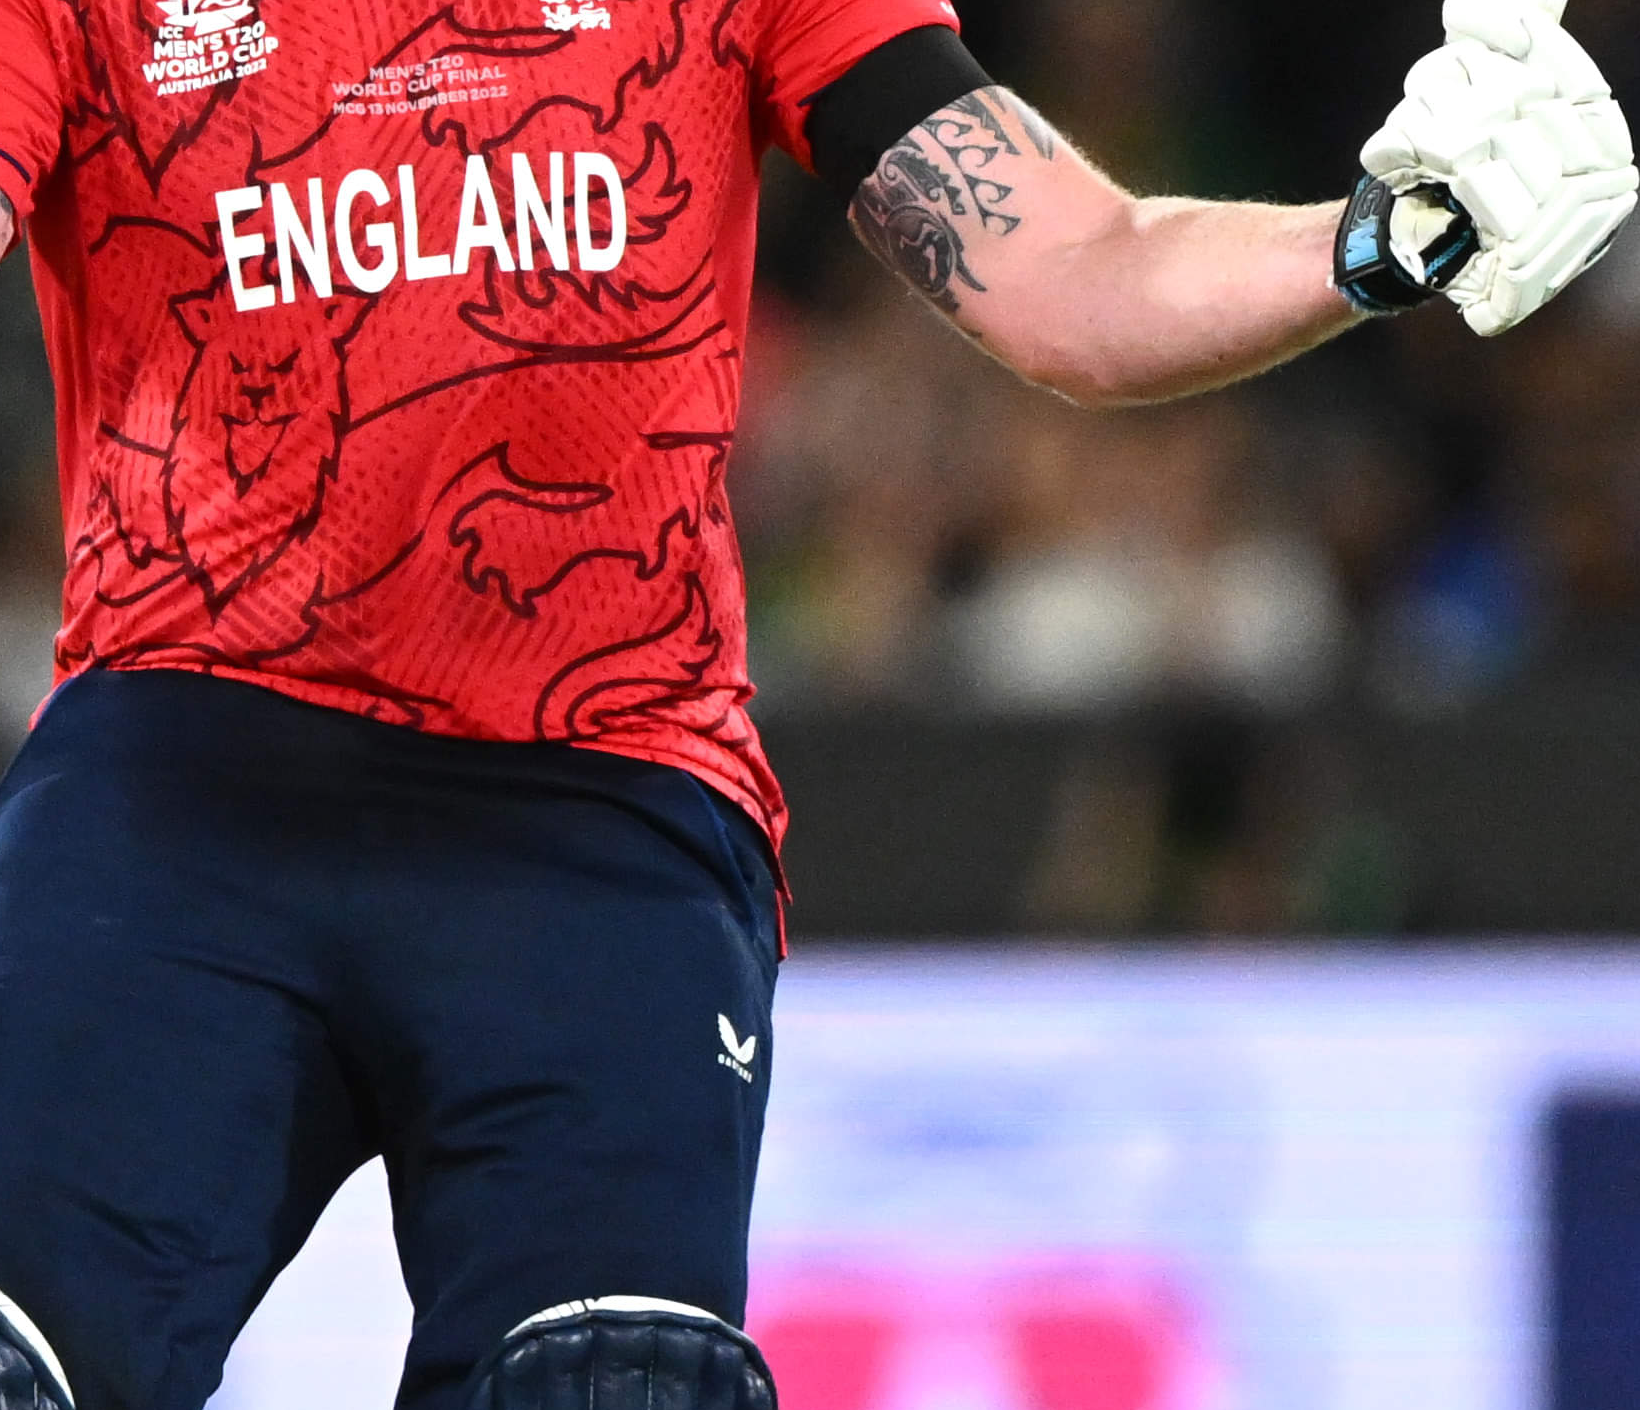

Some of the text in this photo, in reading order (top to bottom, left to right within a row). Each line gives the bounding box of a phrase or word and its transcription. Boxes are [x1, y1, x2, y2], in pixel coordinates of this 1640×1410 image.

[153, 21, 266, 60] MEN'S T20
[158, 26, 184, 39] ICC
[142, 36, 279, 83] WORLD CUP
[369, 55, 464, 81] MEN'S T20
[157, 58, 267, 97] AUSTRALIA 2022
[332, 65, 506, 96] WORLD CUP FINAL
[333, 85, 508, 115] MCG 13 NOVEMBER 2022
[215, 151, 627, 312] ENGLAND
